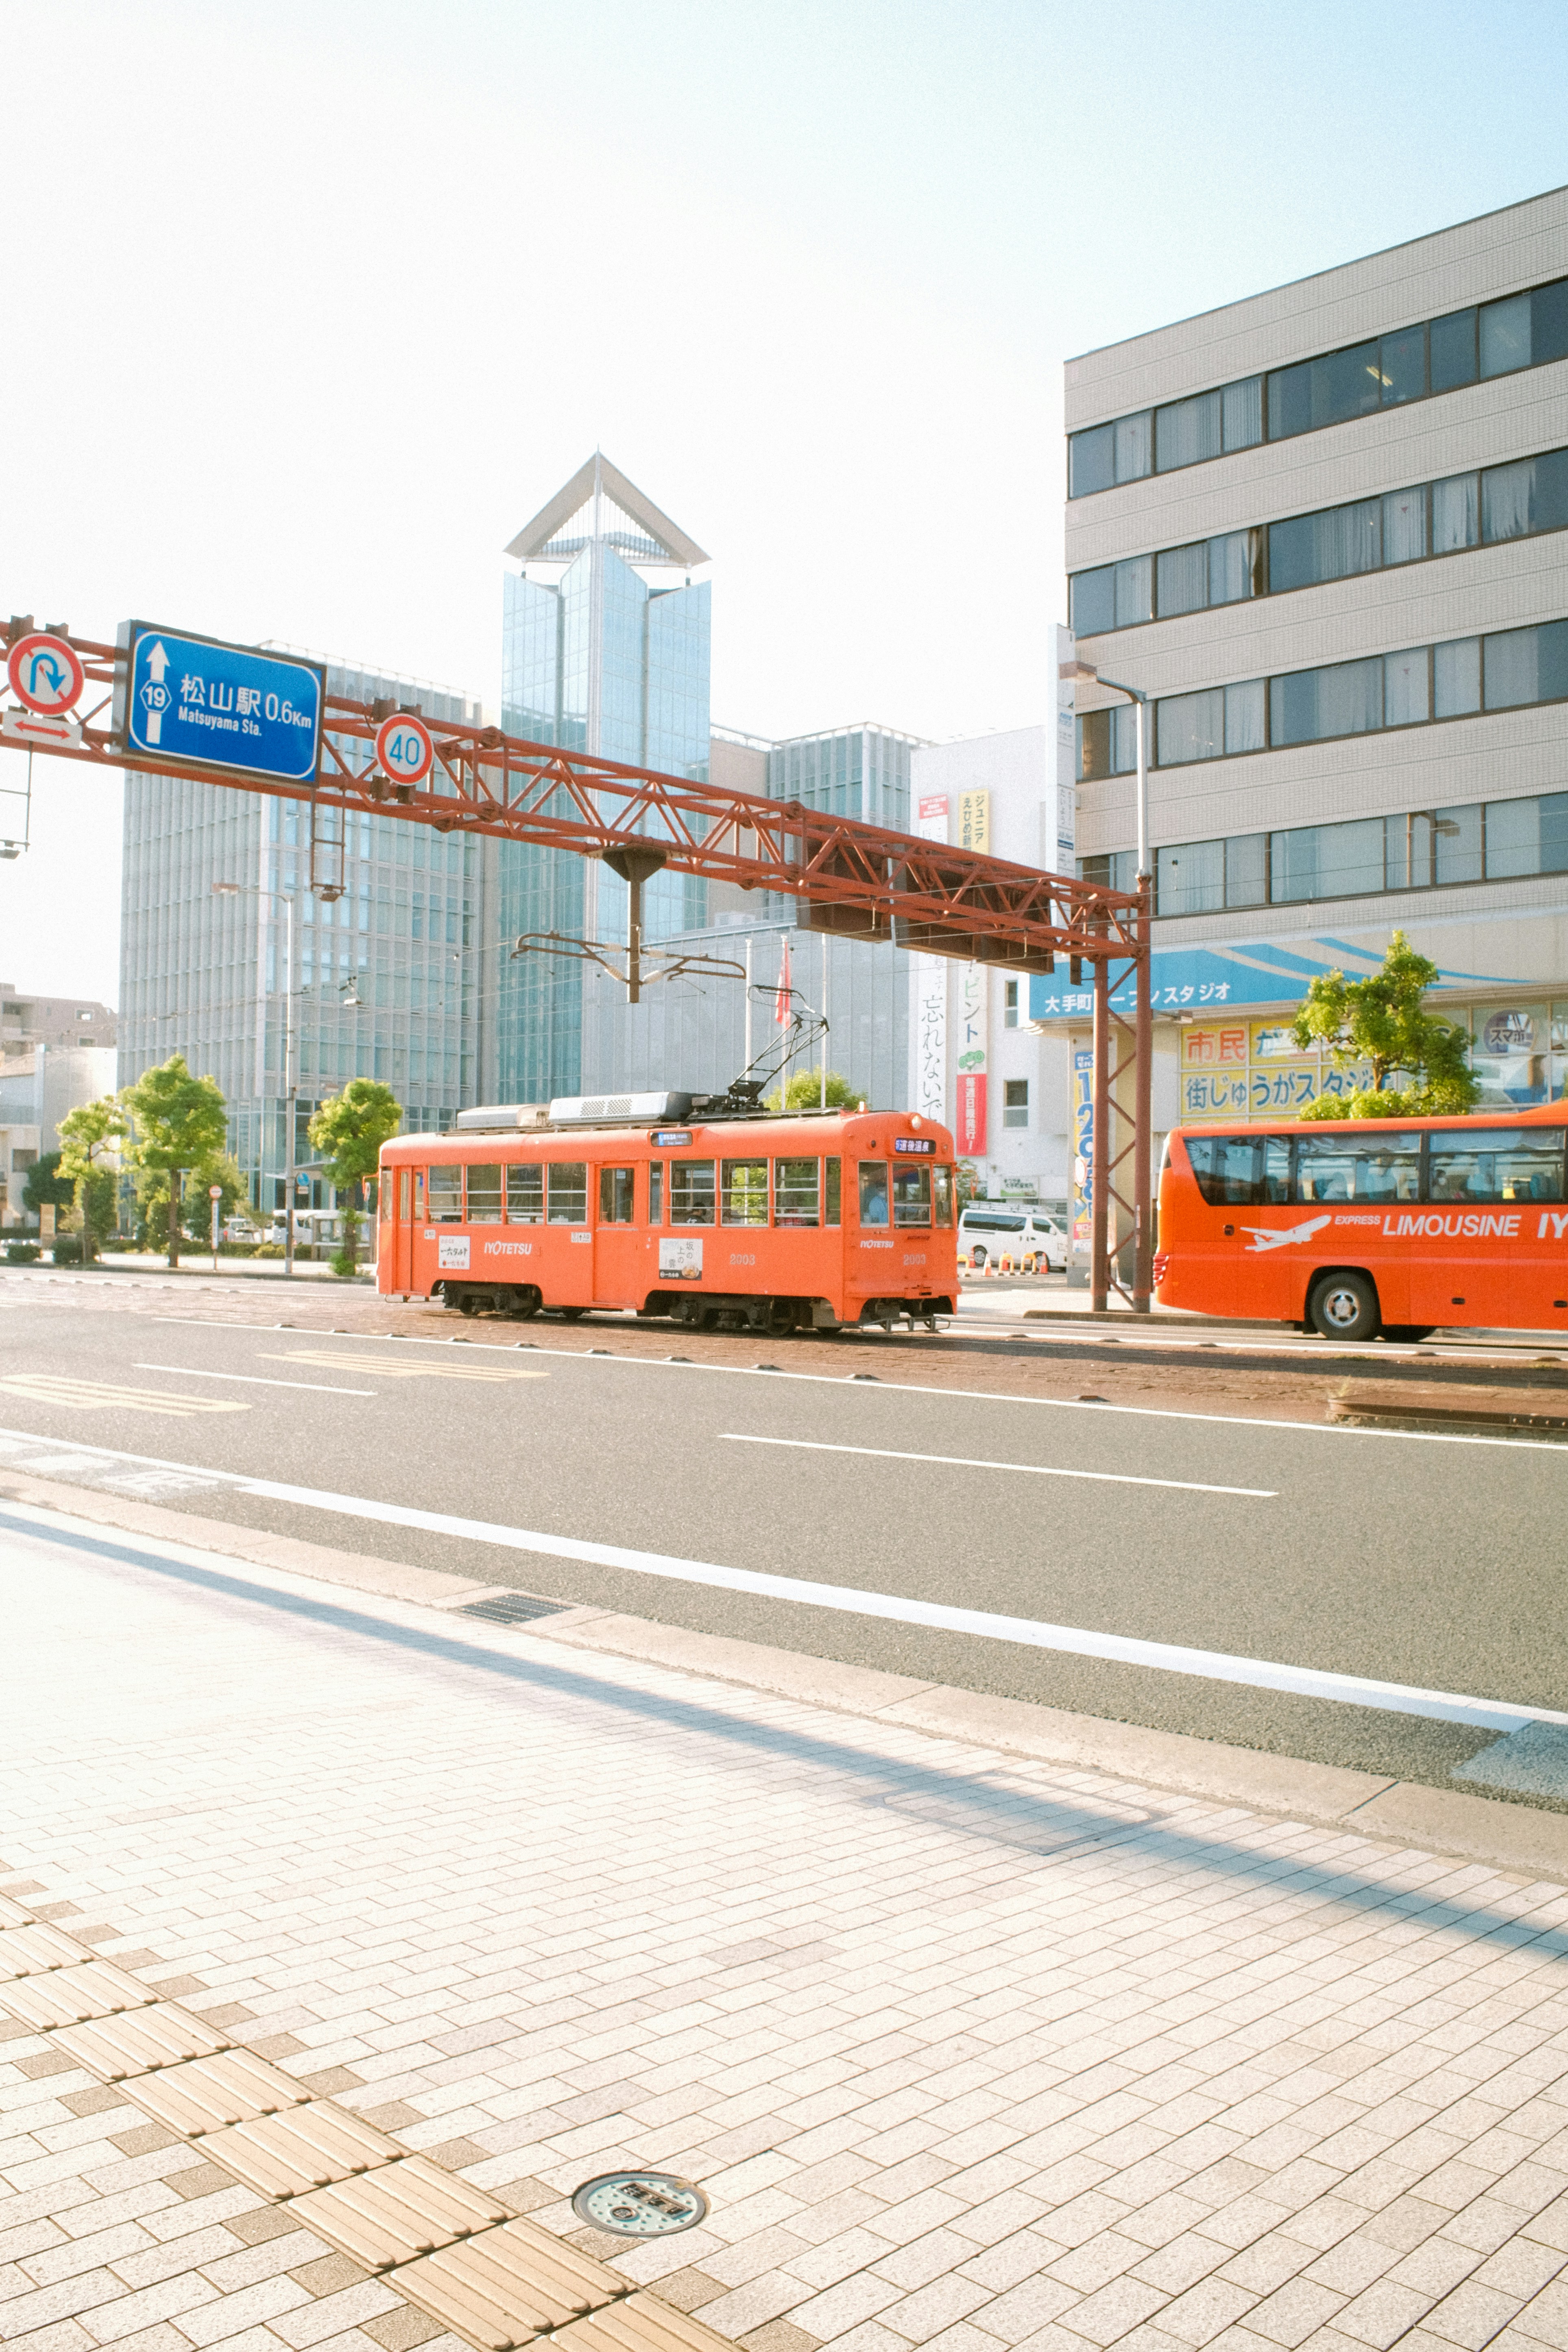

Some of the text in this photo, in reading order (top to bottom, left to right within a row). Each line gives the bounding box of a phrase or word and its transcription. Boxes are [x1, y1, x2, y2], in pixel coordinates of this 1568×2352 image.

[145, 685, 166, 704] 19
[180, 673, 261, 718] 松山駅
[178, 705, 262, 737] Matsuyama Sta.
[389, 737, 420, 766] 40
[1045, 982, 1230, 1013] 大手町ースタジオ
[1335, 1213, 1568, 1239] EXPRESS LIMOUSINE IY
[484, 1240, 532, 1255] IYOTETSU
[860, 1239, 894, 1248] IYOTETSU
[730, 1253, 755, 1266] 2003
